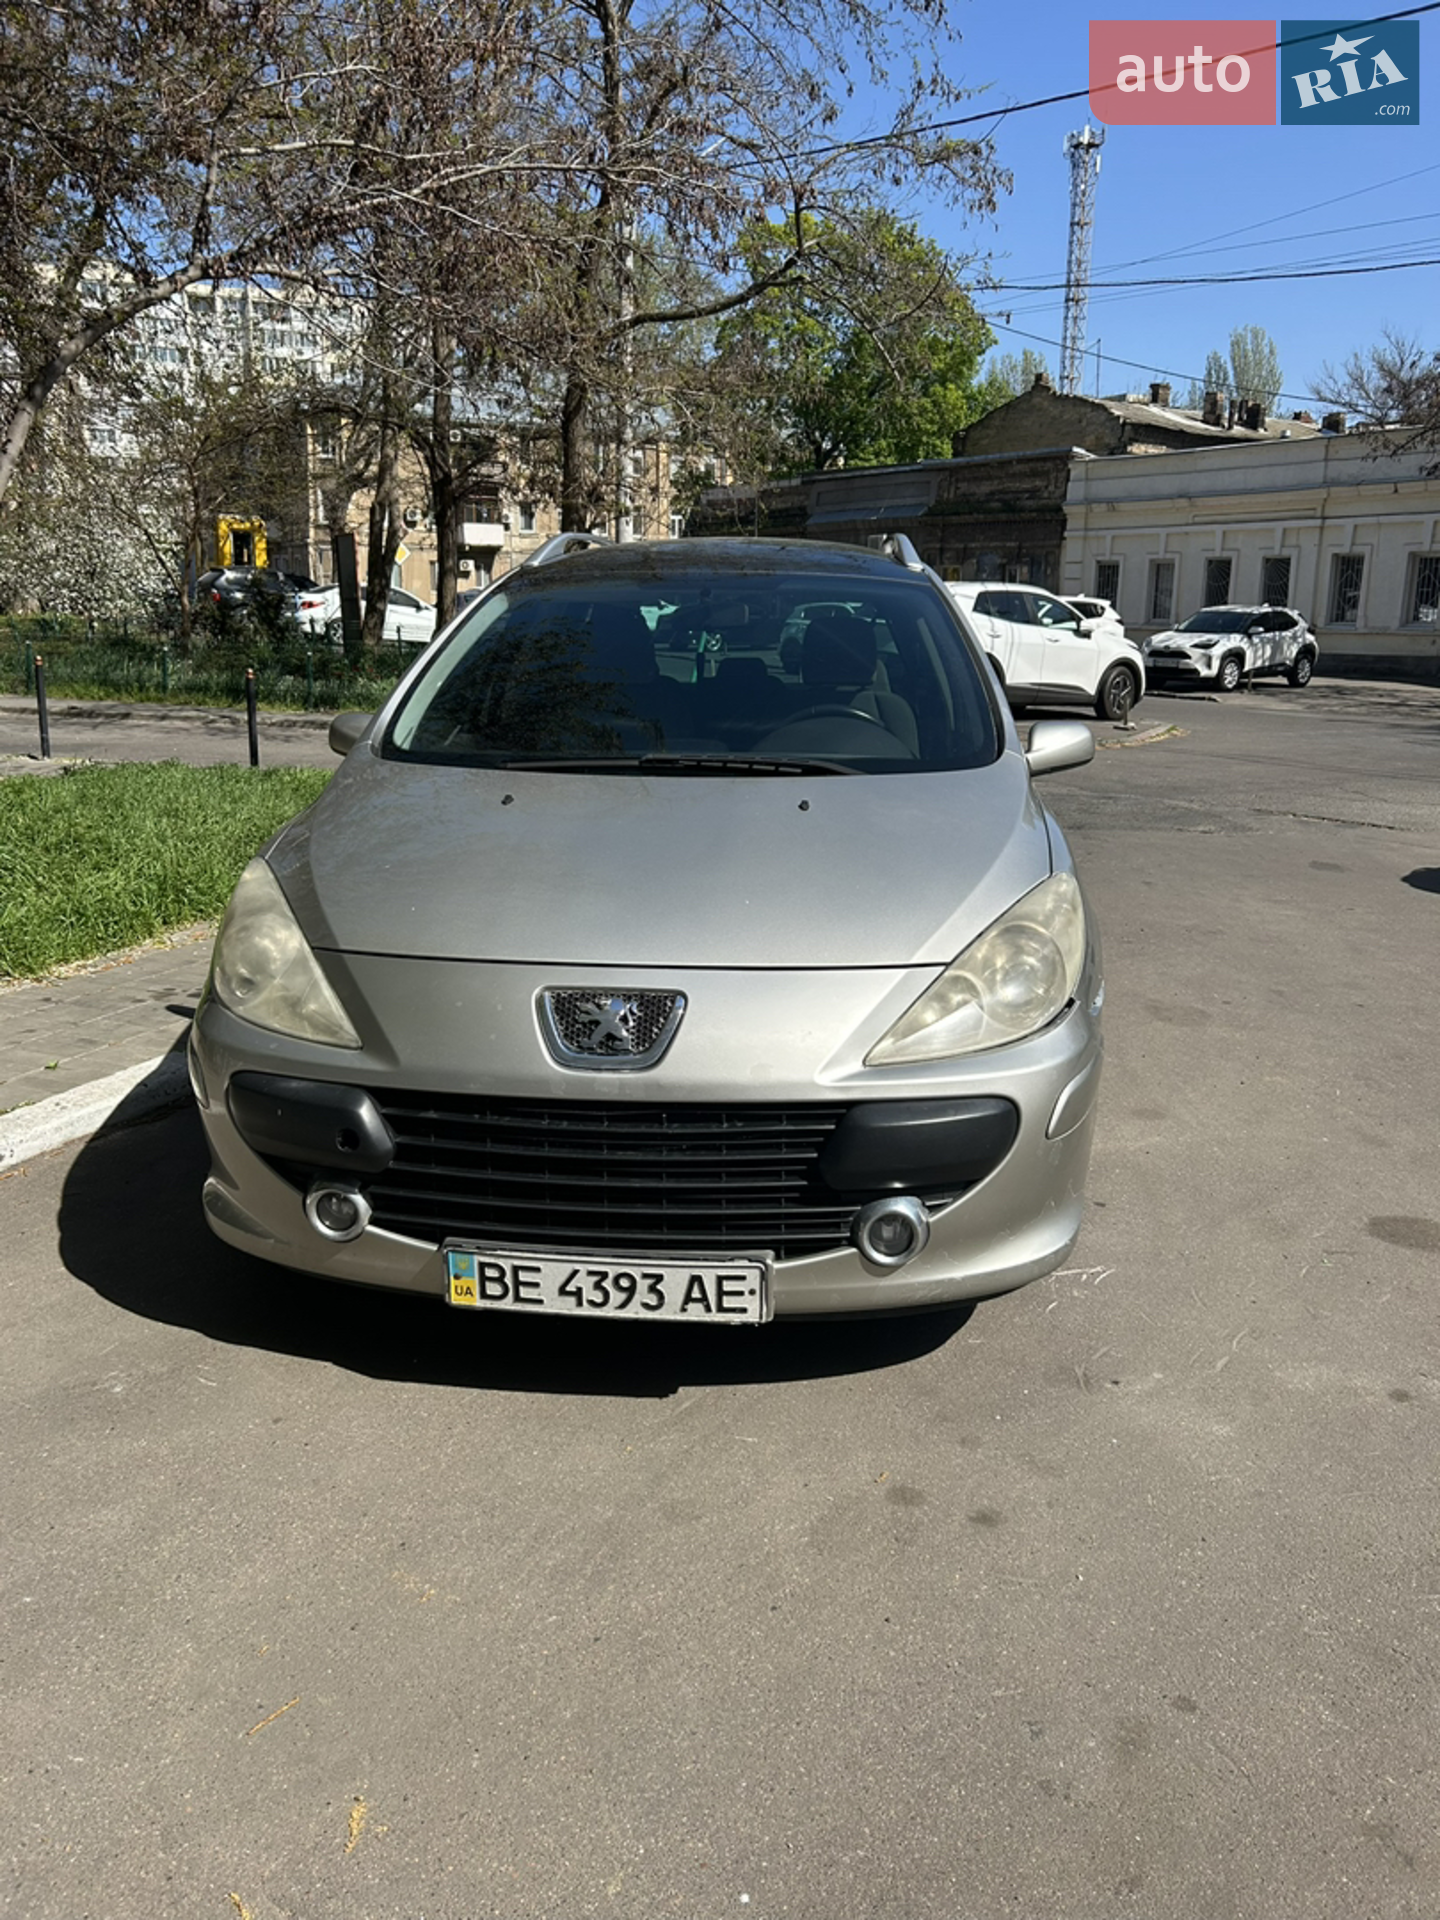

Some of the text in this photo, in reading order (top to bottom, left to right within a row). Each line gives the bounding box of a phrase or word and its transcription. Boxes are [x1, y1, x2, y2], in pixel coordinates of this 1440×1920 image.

[454, 1284, 474, 1298] UA
[478, 1261, 748, 1314] BE 4393 AE
